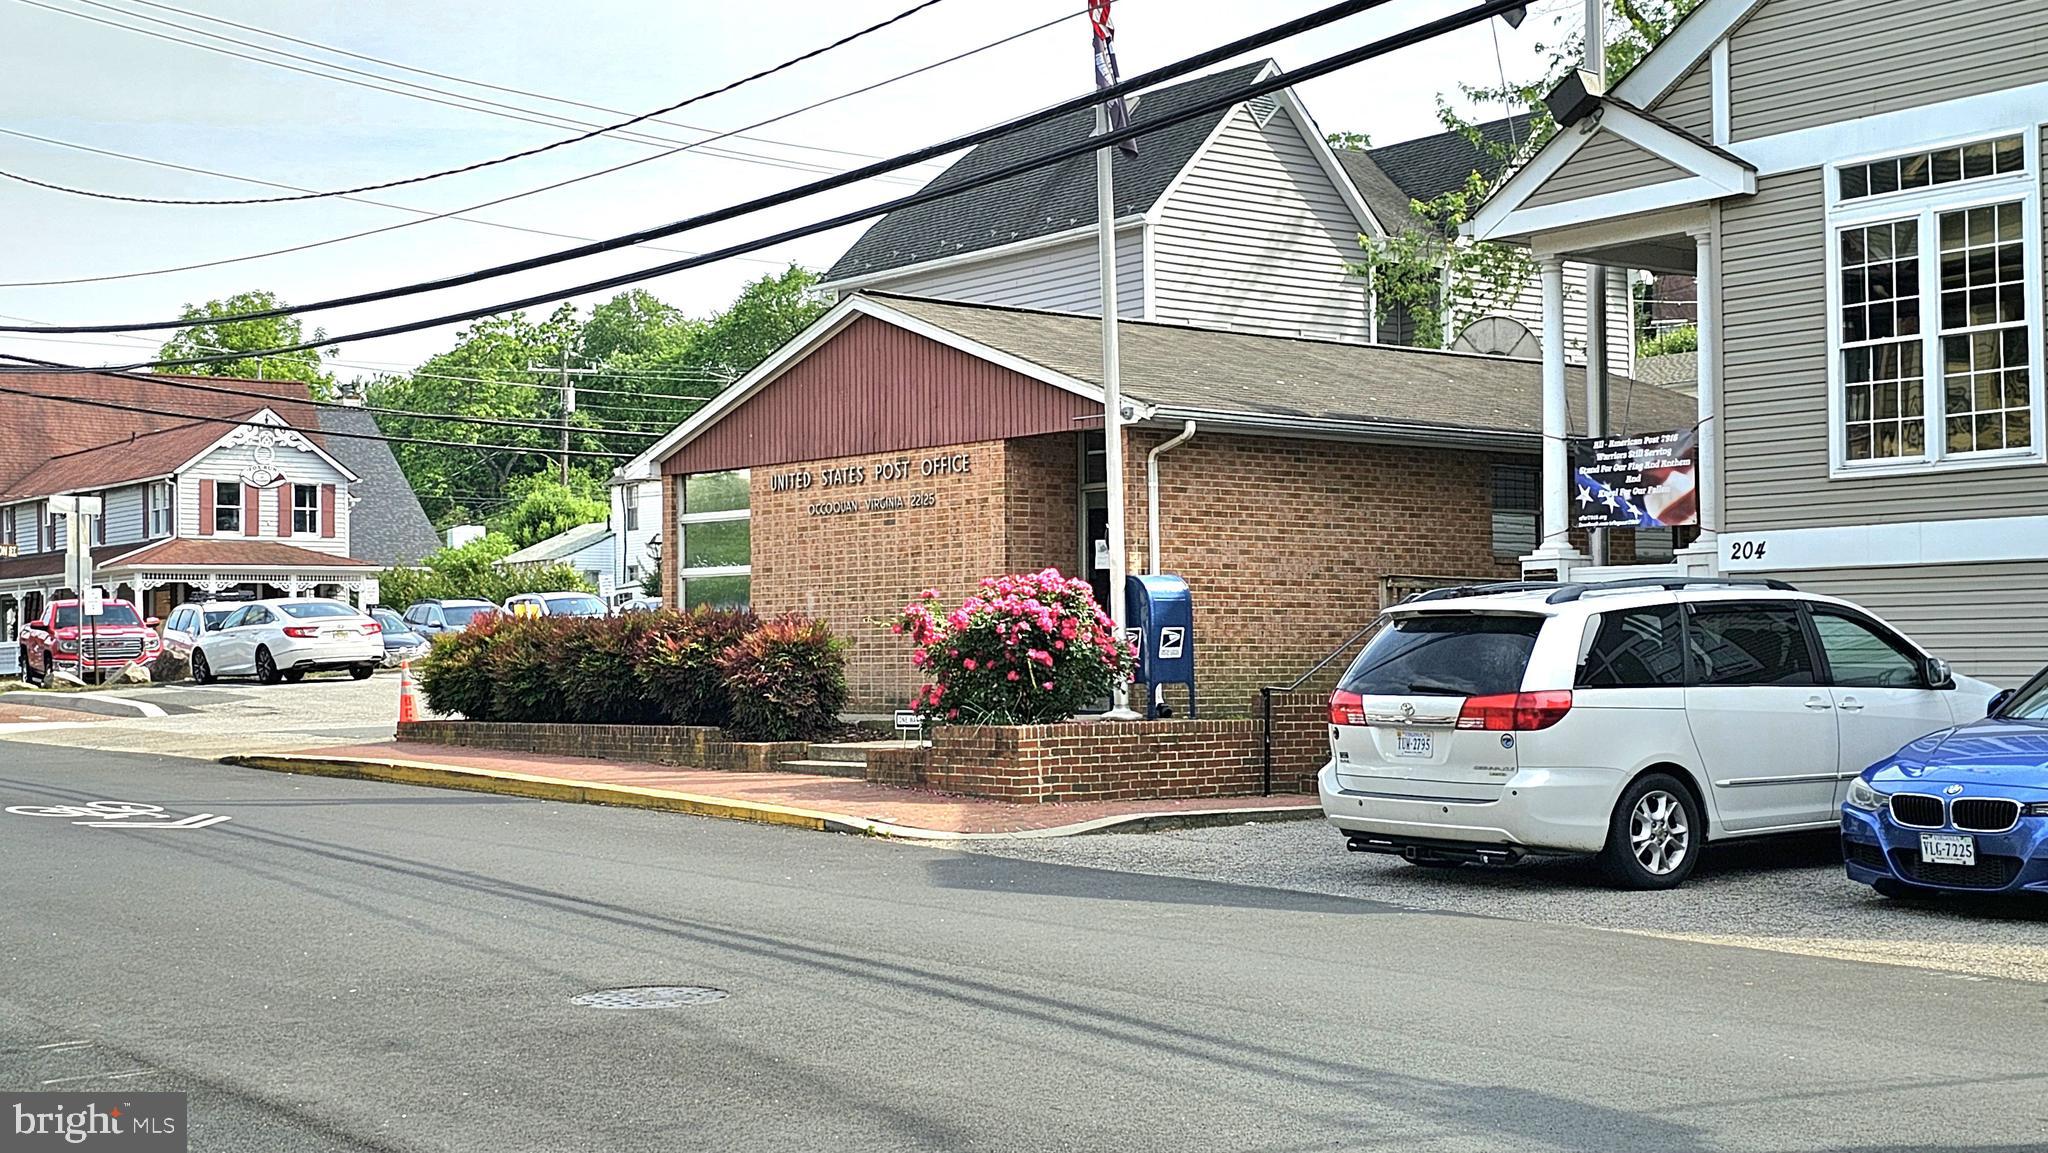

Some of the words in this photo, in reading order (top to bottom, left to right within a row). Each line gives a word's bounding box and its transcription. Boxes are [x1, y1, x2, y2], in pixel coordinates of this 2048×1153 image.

[1608, 438, 1642, 449] American
[1644, 436, 1659, 444] Post
[1596, 452, 1627, 461] Warriors
[1628, 449, 1643, 458] Still
[1644, 448, 1672, 457] Serving
[770, 471, 811, 491] UNITED
[821, 466, 864, 486] STATES
[875, 460, 909, 481] POST
[921, 454, 970, 476] OFFICE
[1601, 464, 1612, 473] For
[1613, 464, 1626, 472] Our
[1628, 461, 1643, 472] Flag
[1633, 487, 1646, 496] Our
[808, 500, 858, 515] OCCOQUAN
[866, 496, 903, 511] VIRGINIA
[910, 493, 935, 507] 22125
[1731, 541, 1766, 559] 204
